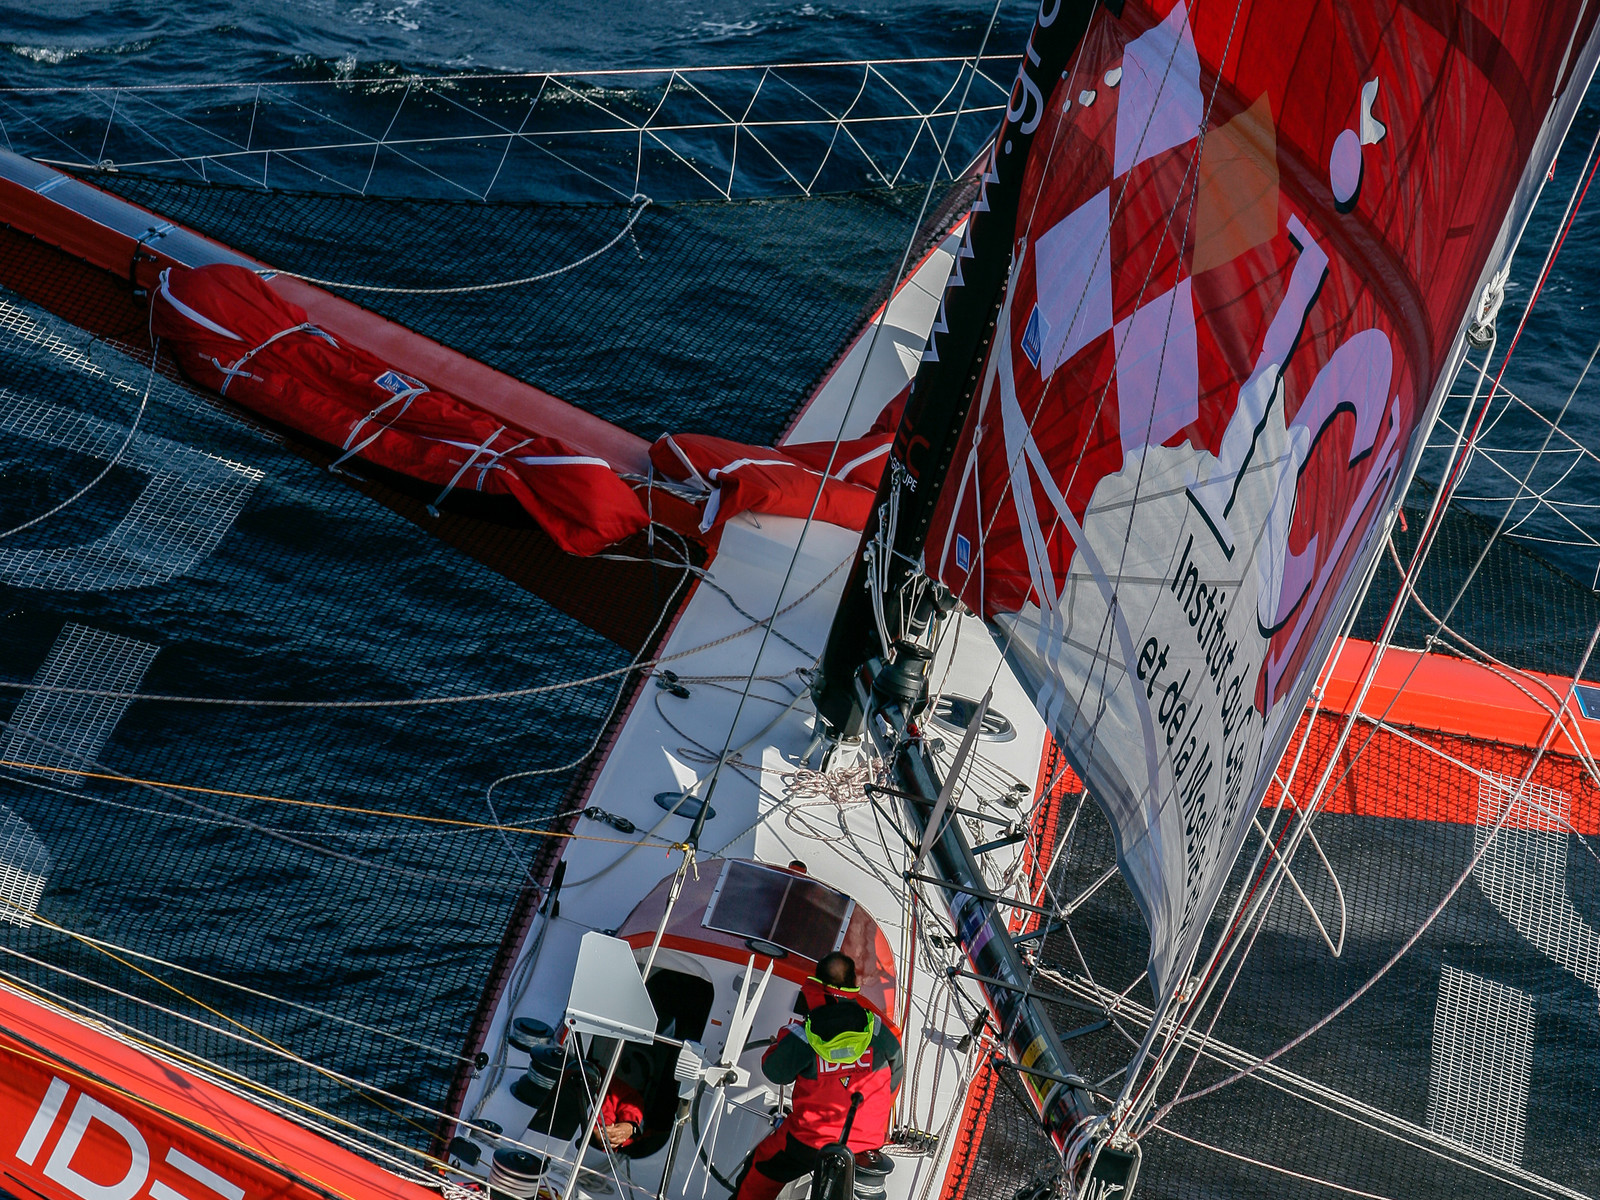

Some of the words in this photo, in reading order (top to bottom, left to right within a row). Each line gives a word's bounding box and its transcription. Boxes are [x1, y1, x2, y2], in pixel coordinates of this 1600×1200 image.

[1136, 636, 1170, 700] et
[1171, 533, 1238, 696] Institut
[1221, 662, 1250, 741] du
[1158, 668, 1192, 746] de
[1173, 703, 1203, 781] la
[819, 1050, 871, 1073] IDC
